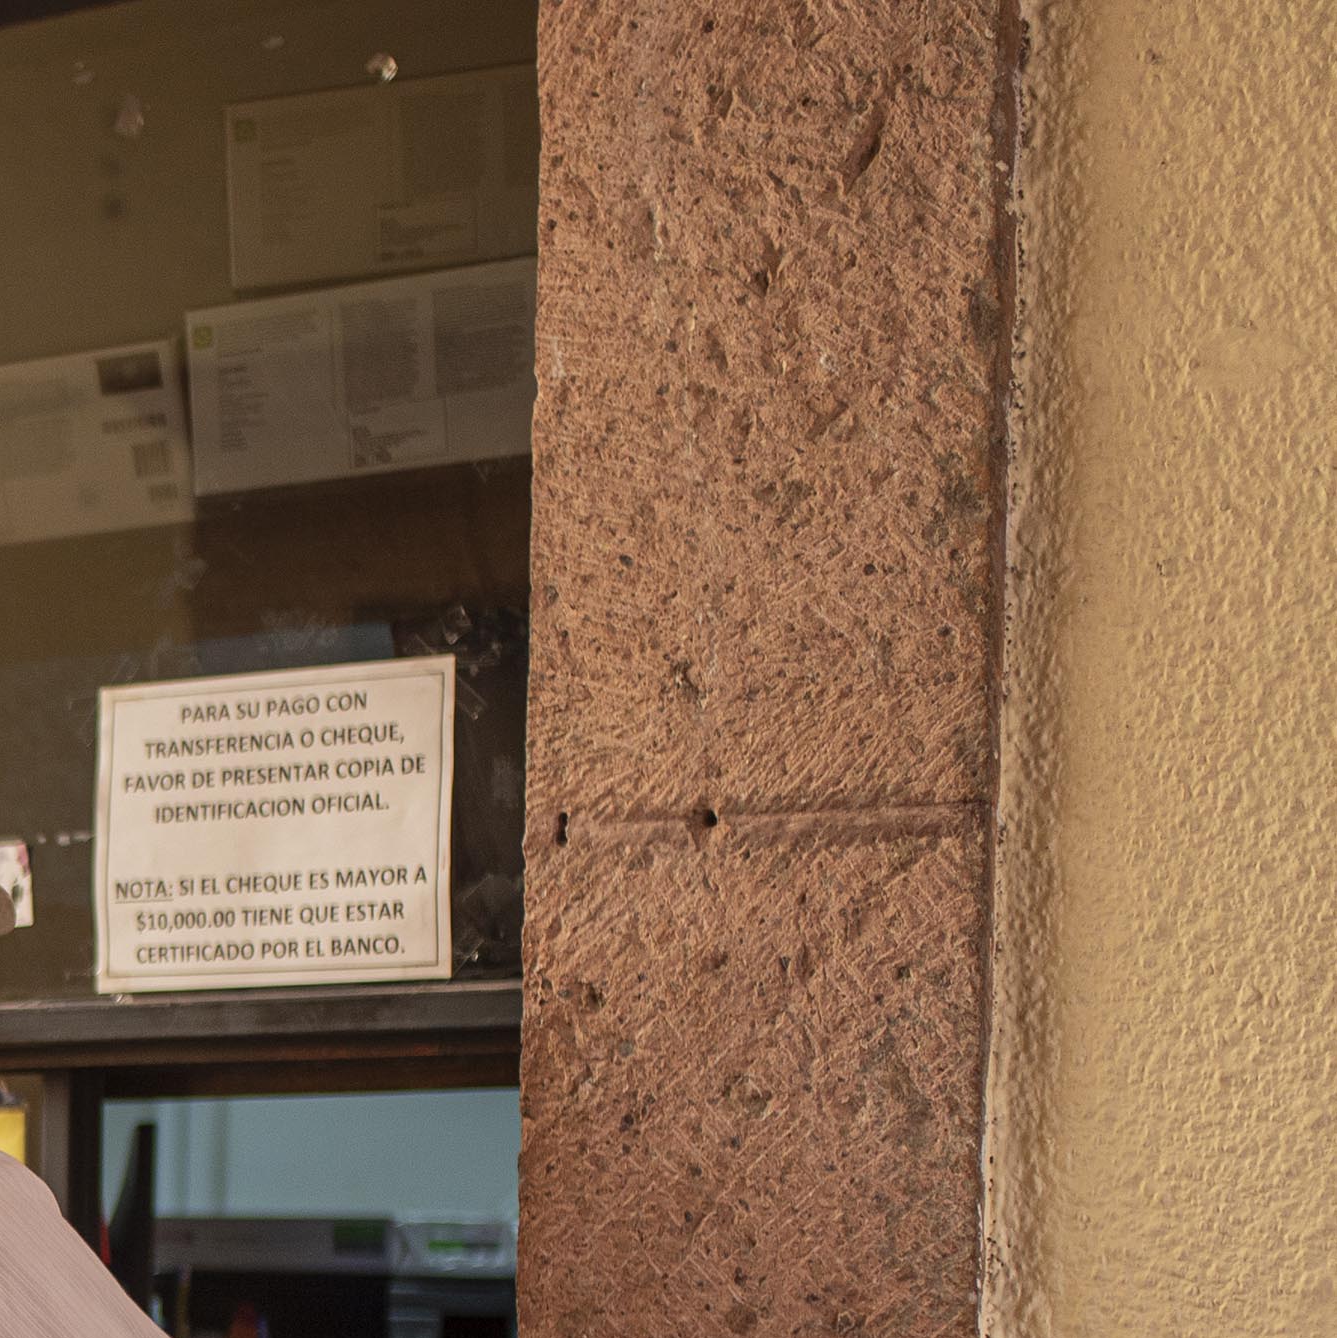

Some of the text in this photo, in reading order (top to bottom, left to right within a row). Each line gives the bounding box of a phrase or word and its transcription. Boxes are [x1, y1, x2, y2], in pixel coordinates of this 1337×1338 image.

[181, 692, 368, 724] PARA SU PAGO CON
[145, 722, 405, 759] TRANSFERENCIA O CHEQUE,
[125, 754, 426, 793] FAVOR DE PRESENTAR COPIA DE
[155, 793, 389, 823] IDENTIFICACION OFICIAL.
[115, 866, 427, 900] NOTA: SI EL CHEQUE ES MAYOR A
[136, 900, 405, 933] $10,000.00 TIENE QUE ESTAR
[136, 937, 405, 964] CERTIFICADO POR EL BANCO.
